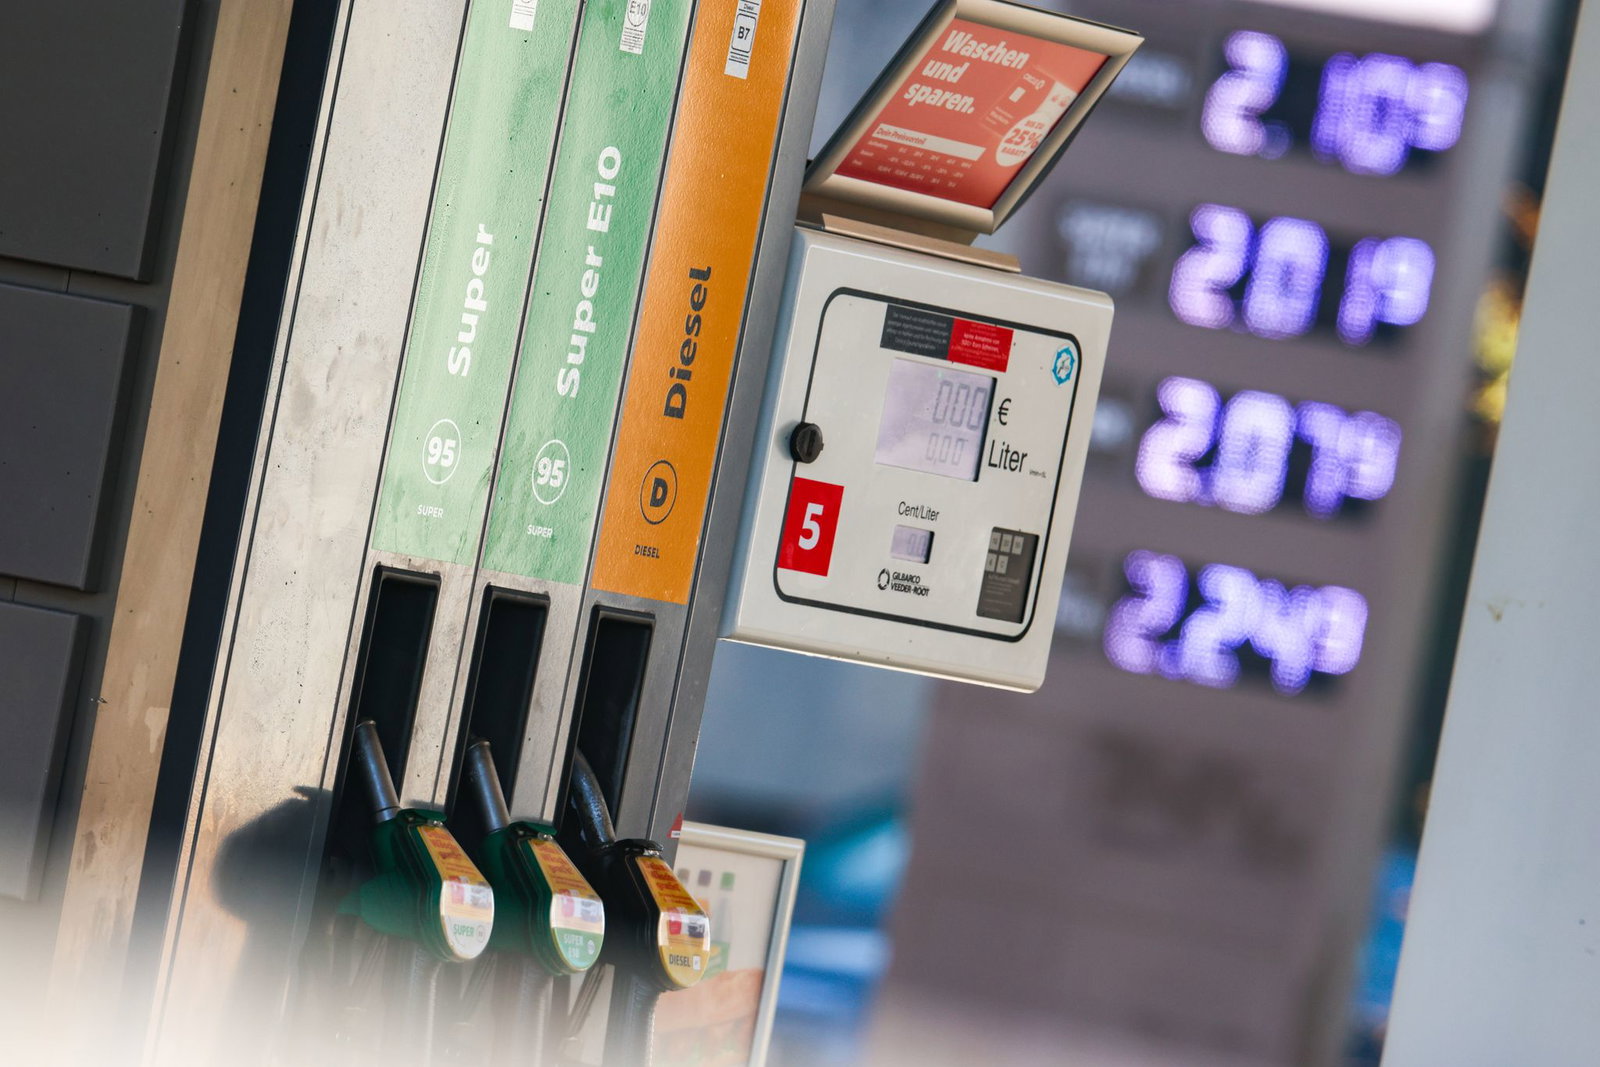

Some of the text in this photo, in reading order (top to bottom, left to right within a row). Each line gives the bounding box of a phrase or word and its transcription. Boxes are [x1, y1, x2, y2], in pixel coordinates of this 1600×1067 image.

[736, 26, 750, 41] B7
[942, 30, 1030, 70] Waschen
[922, 59, 968, 83] und
[903, 83, 975, 114] sparen.
[1003, 128, 1043, 149] 25%
[557, 146, 622, 398] Super E10
[448, 223, 494, 377] Super
[663, 266, 712, 419] Diesel
[998, 398, 1012, 426] €
[427, 436, 457, 468] 95
[988, 439, 1028, 473] Liter
[537, 456, 564, 489] 95
[650, 477, 668, 508] D
[417, 504, 443, 518] SUPER
[898, 501, 940, 522] Cent/Liter
[527, 524, 553, 539] SUPER
[798, 502, 824, 551] 5
[634, 544, 660, 559] DIESEL
[891, 582, 930, 597] VEEDER-ROOT
[892, 571, 921, 585] GILBARCO
[453, 923, 475, 938] SUPER
[562, 933, 584, 946] SUPER
[669, 953, 692, 968] DIESEL
